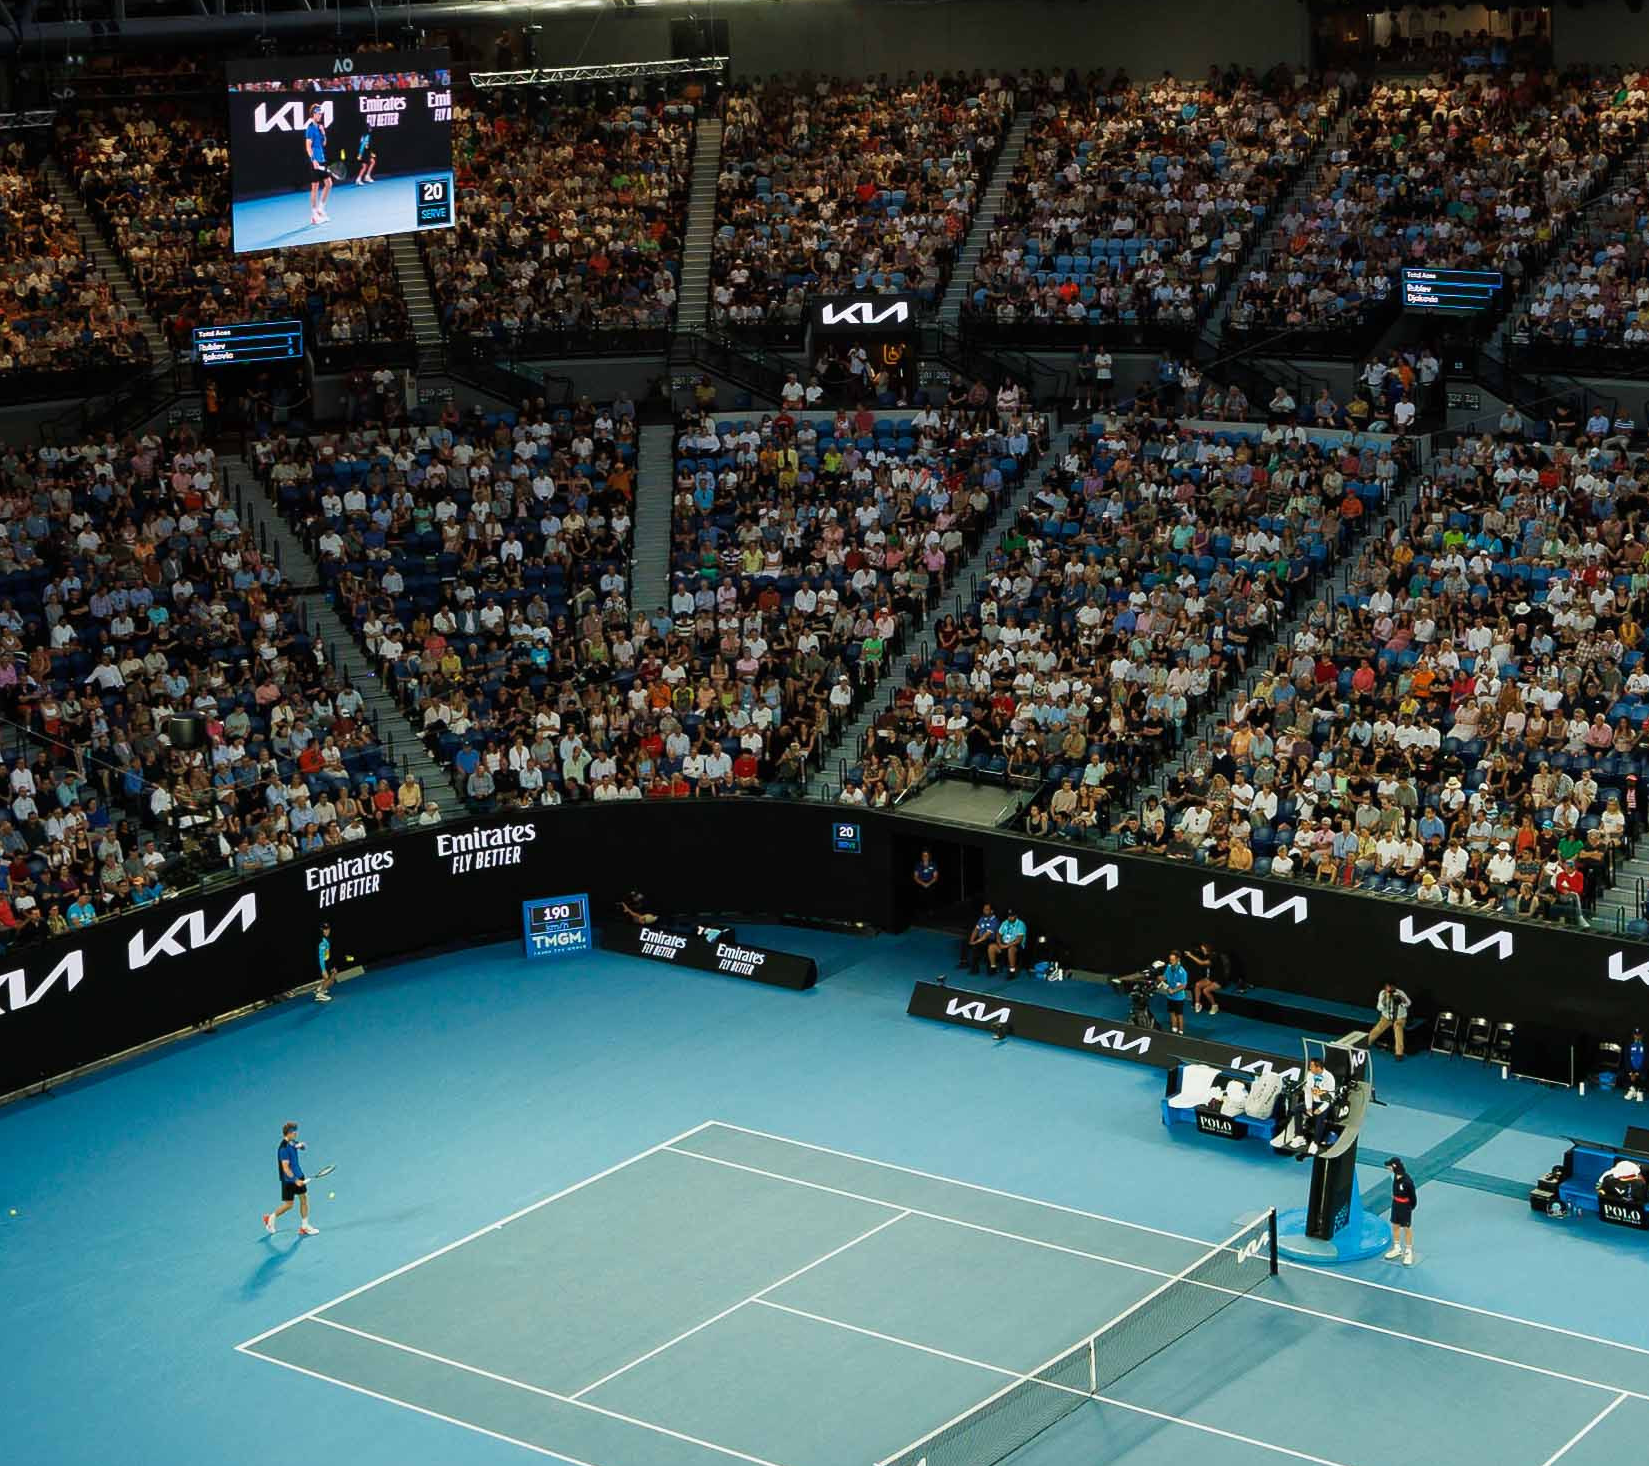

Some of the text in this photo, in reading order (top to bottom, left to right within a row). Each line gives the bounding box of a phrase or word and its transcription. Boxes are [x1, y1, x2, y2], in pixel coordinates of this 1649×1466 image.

[359, 93, 407, 113] Emirates
[254, 99, 334, 133] KIA
[423, 183, 443, 202] 20
[421, 208, 448, 220] SERVE
[823, 301, 909, 325] KIA
[437, 823, 536, 857] Emirates
[838, 826, 854, 838] 20
[305, 850, 395, 892] Emirates
[452, 845, 522, 875] FLY BETTER
[1021, 849, 1119, 891] KIA
[319, 873, 381, 909] FLY BETTER
[1202, 881, 1308, 924] KIA
[542, 904, 570, 922] 190
[128, 889, 257, 970] KIA
[639, 927, 688, 949] Emirates
[1399, 914, 1514, 960] KIA
[653, 944, 677, 960] BETTER
[716, 942, 766, 965] Emirates
[732, 960, 756, 976] BETTER
[945, 997, 1011, 1024] KIA
[1082, 1025, 1152, 1055] KIA
[1200, 1116, 1232, 1131] POLO
[1604, 1204, 1641, 1221] POLO
